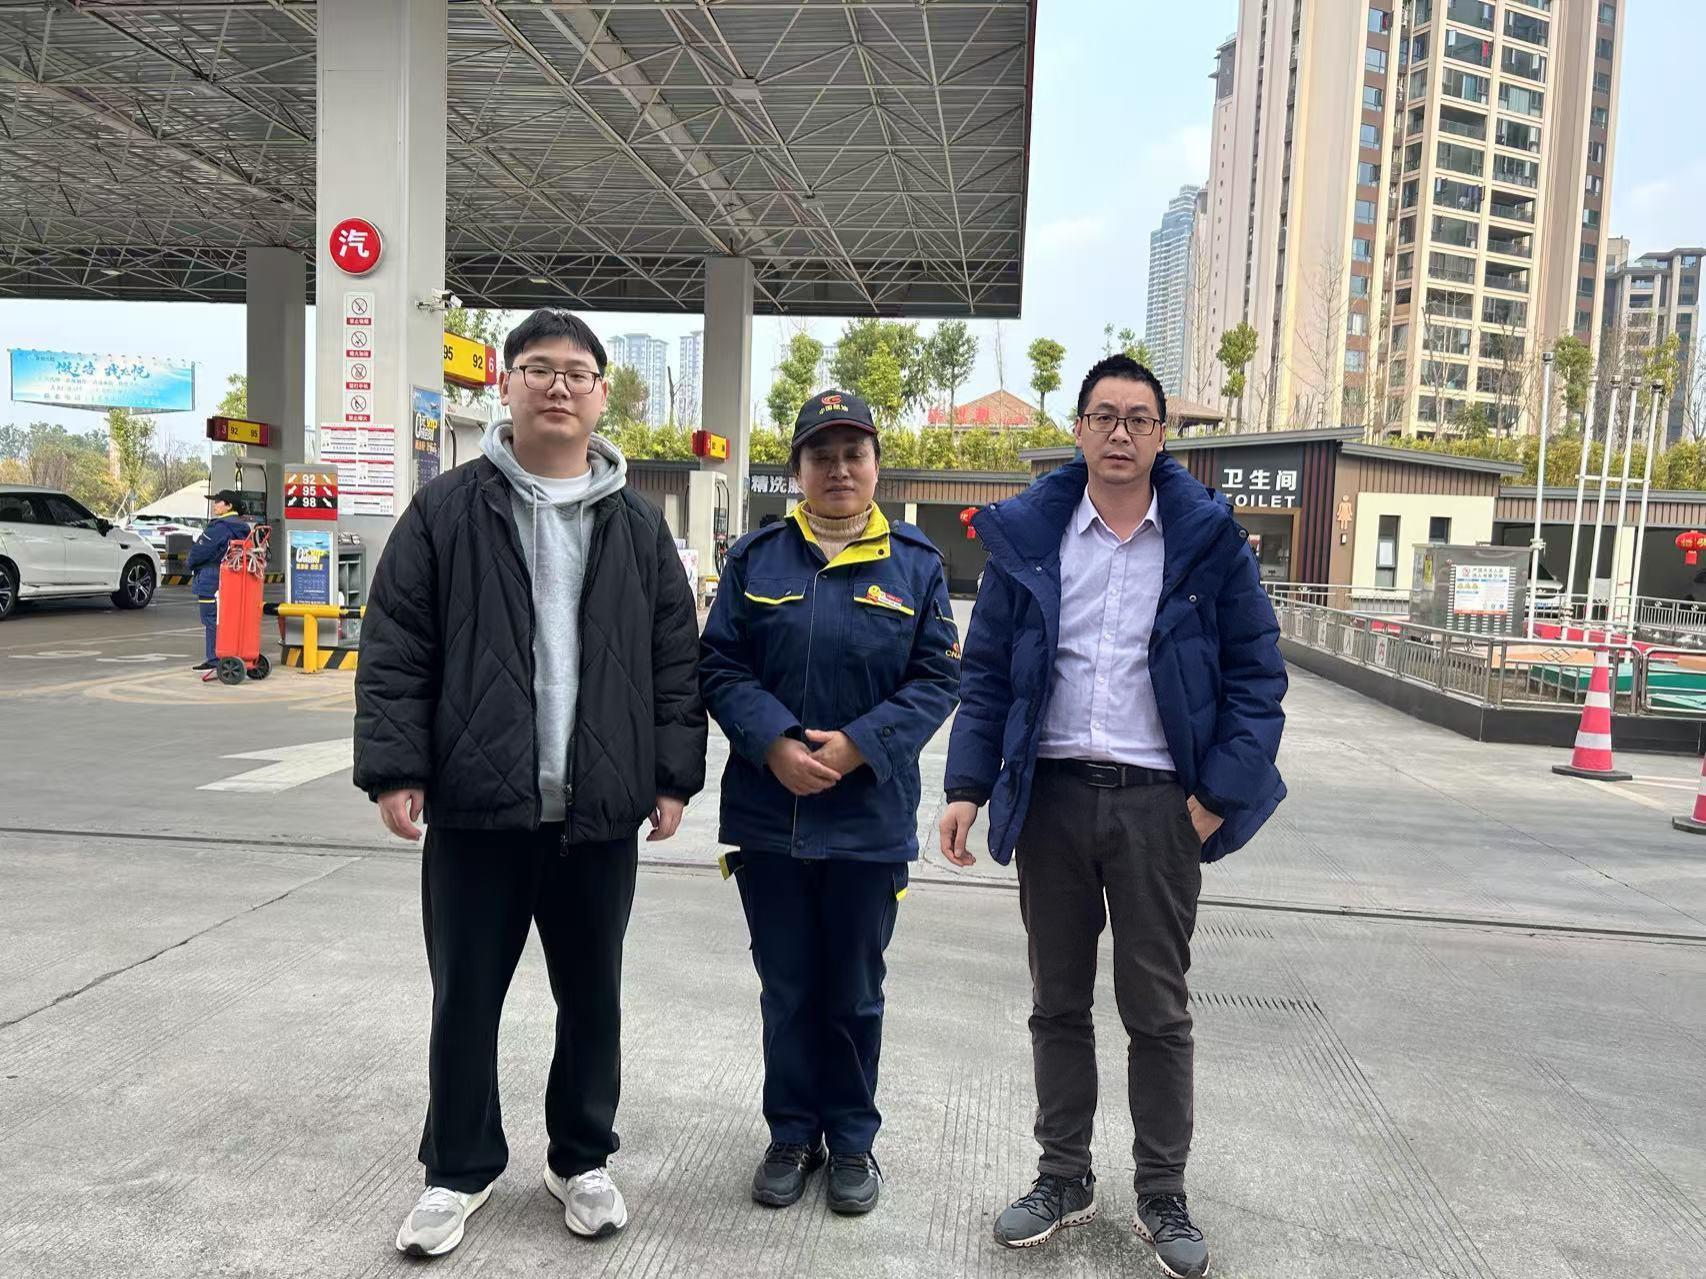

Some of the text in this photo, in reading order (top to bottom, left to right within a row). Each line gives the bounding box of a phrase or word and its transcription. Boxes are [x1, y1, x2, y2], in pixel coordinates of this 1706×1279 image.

[338, 228, 370, 258] 汽
[472, 353, 483, 370] 92
[488, 357, 495, 373] 6
[230, 426, 238, 435] 92
[250, 429, 258, 438] 95
[302, 474, 316, 485] 92
[1221, 468, 1298, 491] 卫生间
[302, 485, 316, 496] 95
[302, 497, 317, 508] 98
[1223, 493, 1297, 508] TOILET
